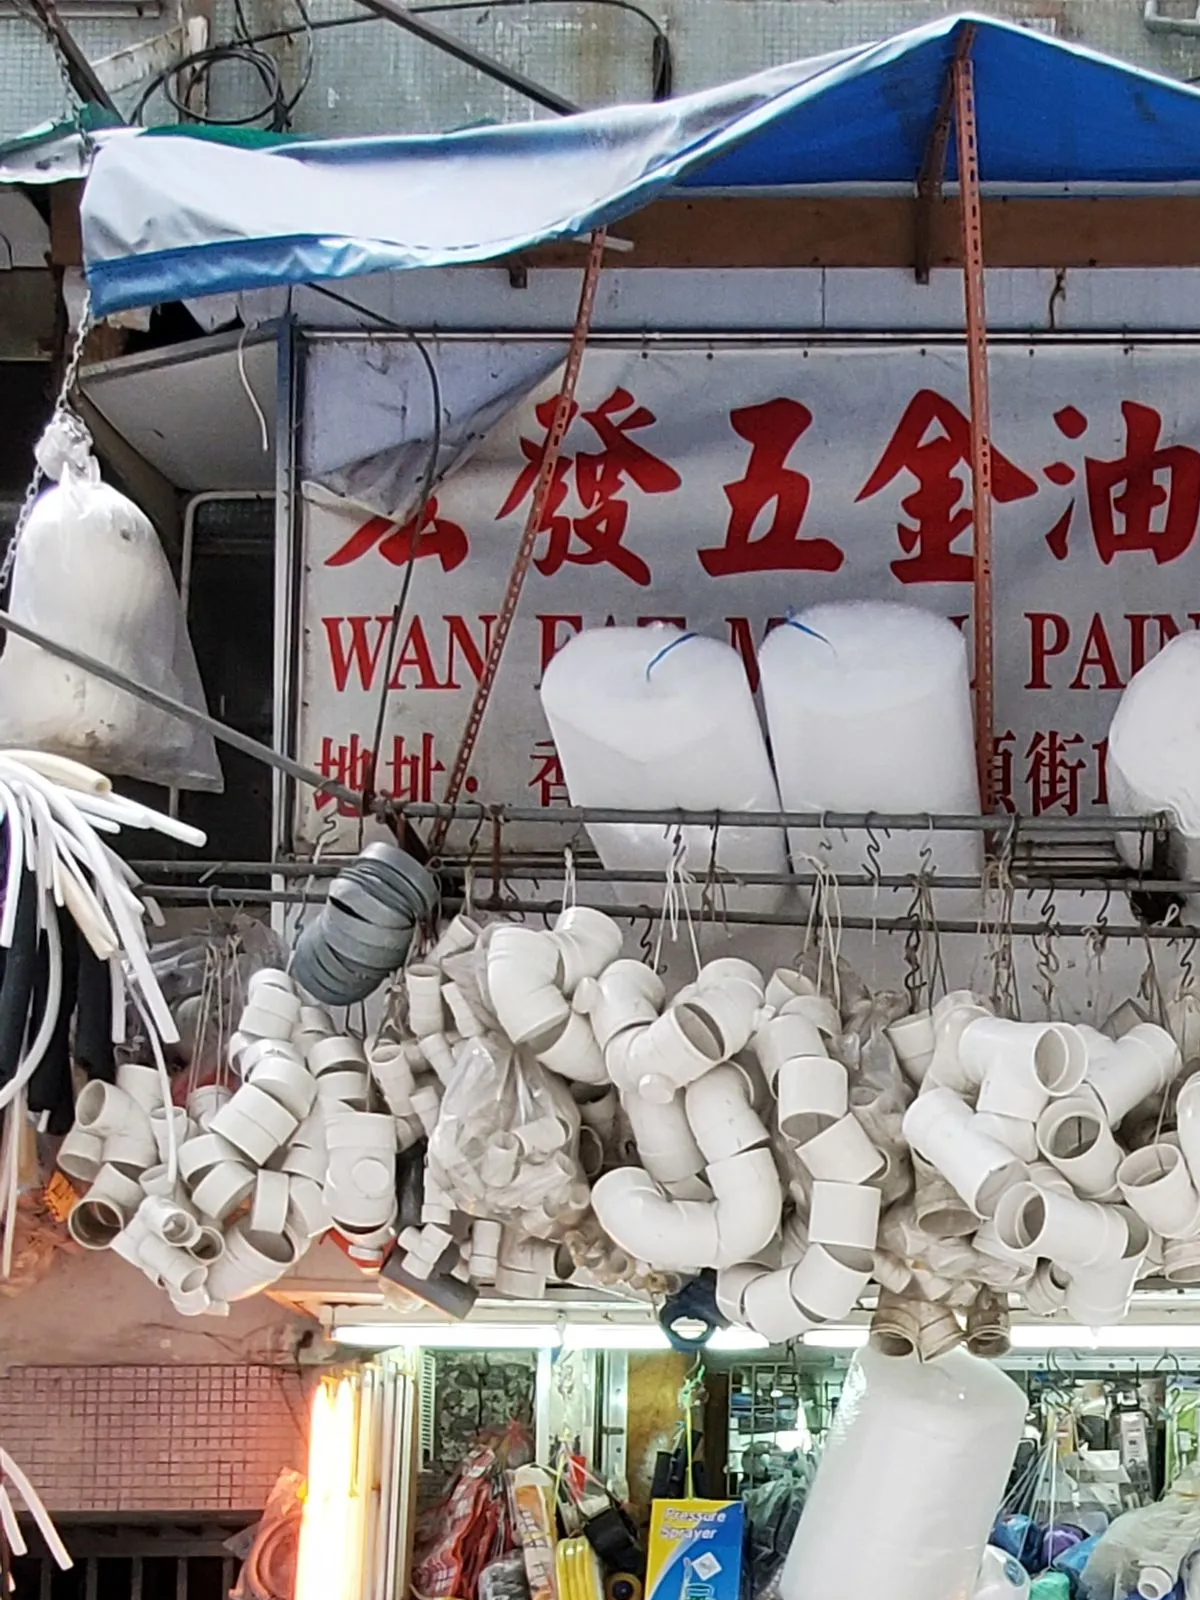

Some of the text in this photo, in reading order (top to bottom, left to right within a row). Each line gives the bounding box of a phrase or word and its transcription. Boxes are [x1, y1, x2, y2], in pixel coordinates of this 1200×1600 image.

[321, 614, 498, 692] WAN
[664, 1507, 727, 1523] Pressure
[660, 1526, 718, 1540] Sprayer
